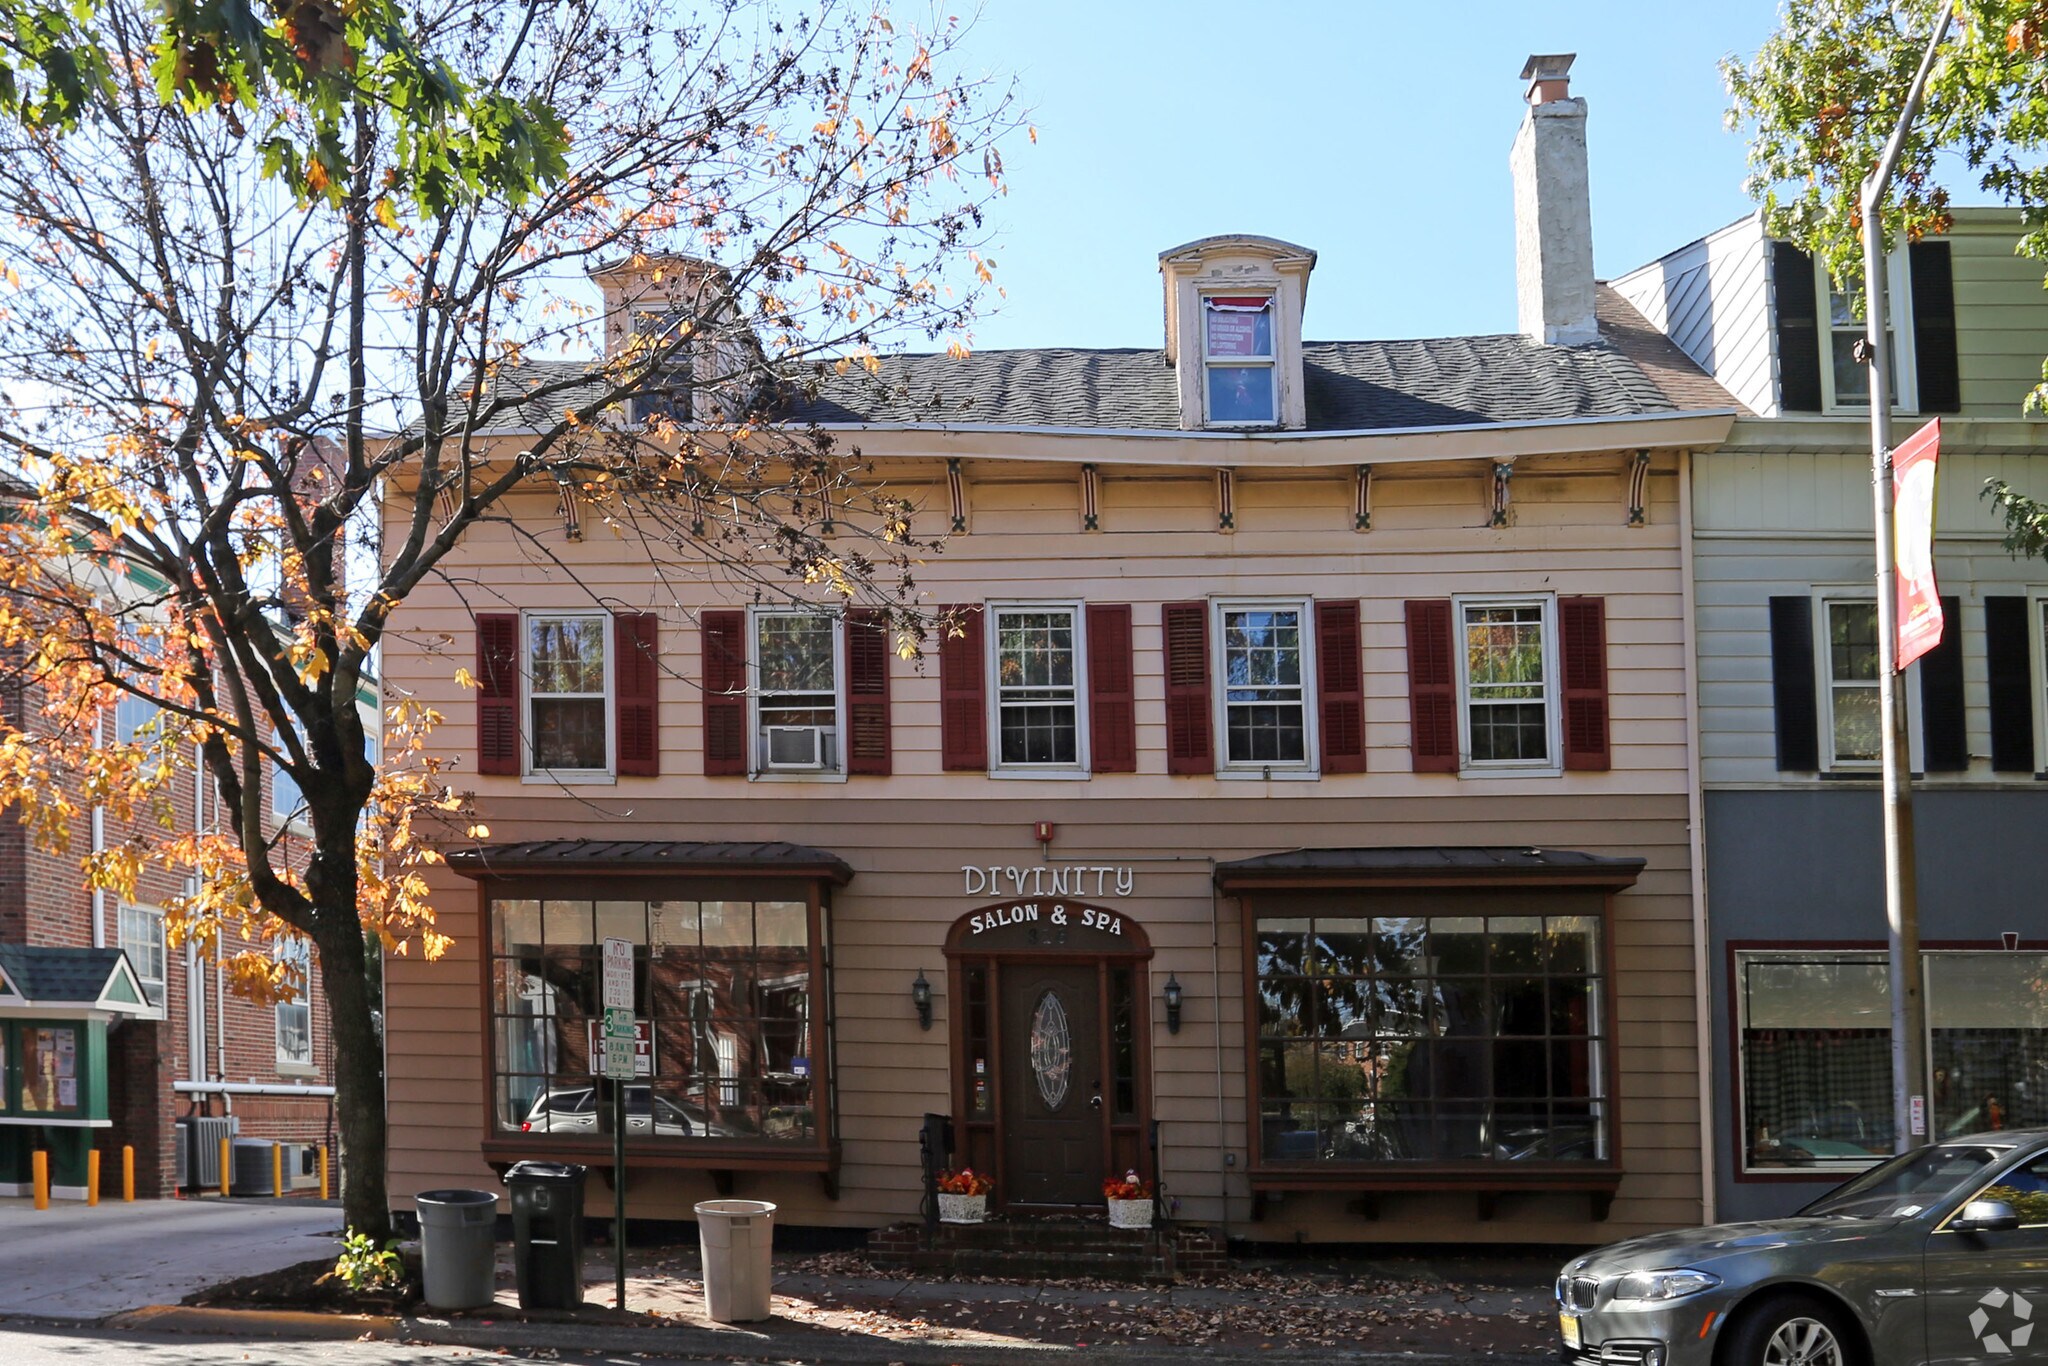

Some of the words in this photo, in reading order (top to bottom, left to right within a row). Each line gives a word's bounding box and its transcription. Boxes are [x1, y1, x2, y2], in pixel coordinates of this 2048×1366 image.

[961, 865, 1134, 896] DIVINITY
[970, 904, 1039, 935] SALON
[1051, 904, 1067, 926] &
[1081, 908, 1122, 936] SPA
[612, 941, 625, 956] NO
[606, 955, 632, 971] PARKING
[605, 1014, 613, 1032] 3
[613, 1023, 633, 1035] PARKING
